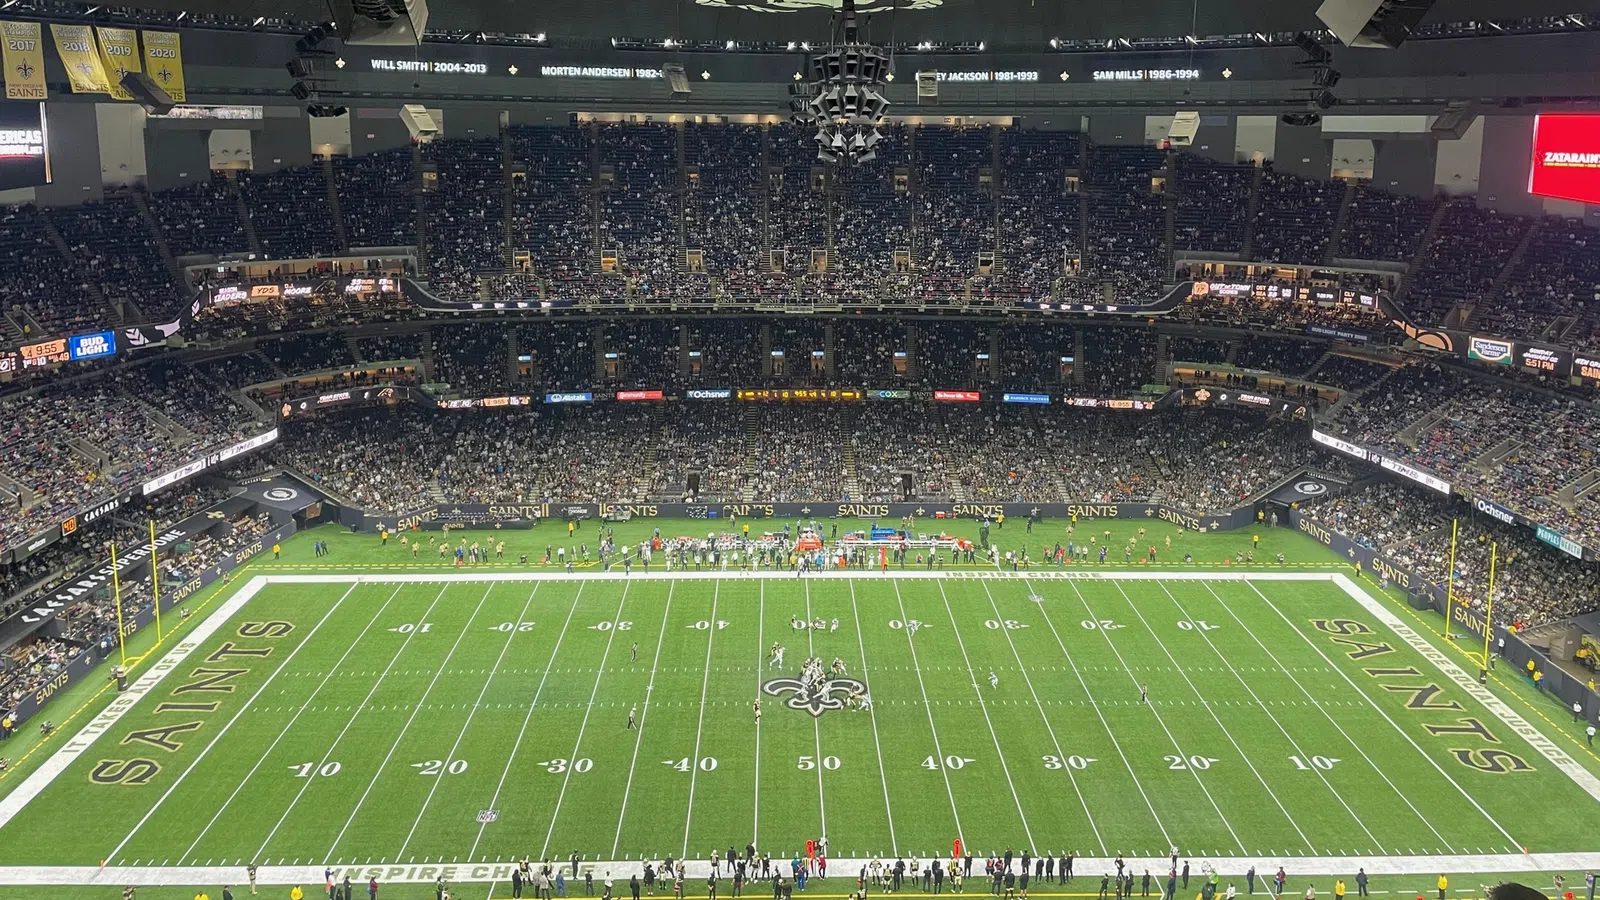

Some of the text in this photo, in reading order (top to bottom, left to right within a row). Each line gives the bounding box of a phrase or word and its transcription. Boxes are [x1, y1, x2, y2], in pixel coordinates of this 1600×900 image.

[9, 40, 36, 50] 2017
[63, 42, 90, 51] 2018
[107, 46, 132, 56] 2019
[149, 48, 176, 58] 2020
[371, 59, 487, 73] WILL SMITH 2004-2013
[541, 66, 581, 76] MORTEN
[582, 67, 630, 77] ANDERSEN
[947, 72, 989, 81] JACKSON
[994, 71, 1038, 80] 1981-1993
[1093, 69, 1199, 79] SAM MILLS 1986-1994
[9, 88, 44, 97] SAINTS
[283, 287, 312, 295] MOORE
[80, 336, 104, 346] BUD
[1475, 341, 1506, 353] Sanderson
[36, 344, 57, 355] 9:55
[76, 343, 109, 357] LIGHT
[1481, 349, 1501, 357] Farms
[1542, 360, 1554, 371] PM
[693, 390, 730, 399] Ochsner
[879, 390, 898, 398] COX
[84, 499, 119, 522] CAESARS
[489, 505, 540, 518] SAINTS
[838, 505, 889, 516] SAINTS
[953, 505, 1003, 516] SAINTS
[1068, 505, 1118, 517] SAINTS
[1478, 500, 1514, 524] Ochsner
[63, 519, 75, 531] 40
[398, 508, 438, 531] SAINTS
[1158, 508, 1200, 531] SAINTS
[1300, 519, 1331, 545] SAINTS
[1537, 527, 1560, 546] PEOPLES
[1561, 541, 1582, 557] HEALTH
[235, 540, 263, 565] SAINTS
[21, 529, 186, 623] CAESARS SUPERDOME
[1372, 557, 1409, 588] SAINTS
[173, 578, 202, 604] SAINTS
[1454, 608, 1495, 643] SAINTS
[36, 671, 69, 704] SAINTS
[1389, 622, 1572, 767] ADVANCE SOCIAL JUSTICE
[62, 641, 197, 754] IT TAKES ALL OF US
[88, 620, 296, 785] SAINTS
[1308, 618, 1537, 774] SAINTS
[295, 761, 341, 777] 10
[417, 759, 469, 775] 20
[546, 758, 594, 773] 30
[673, 757, 718, 772] 40
[797, 756, 842, 771] 50
[921, 756, 966, 771] 40
[1043, 755, 1087, 770] 30
[1164, 755, 1210, 770] 20
[1289, 755, 1334, 771] 10
[333, 866, 595, 880] INSPIRE CHGE
